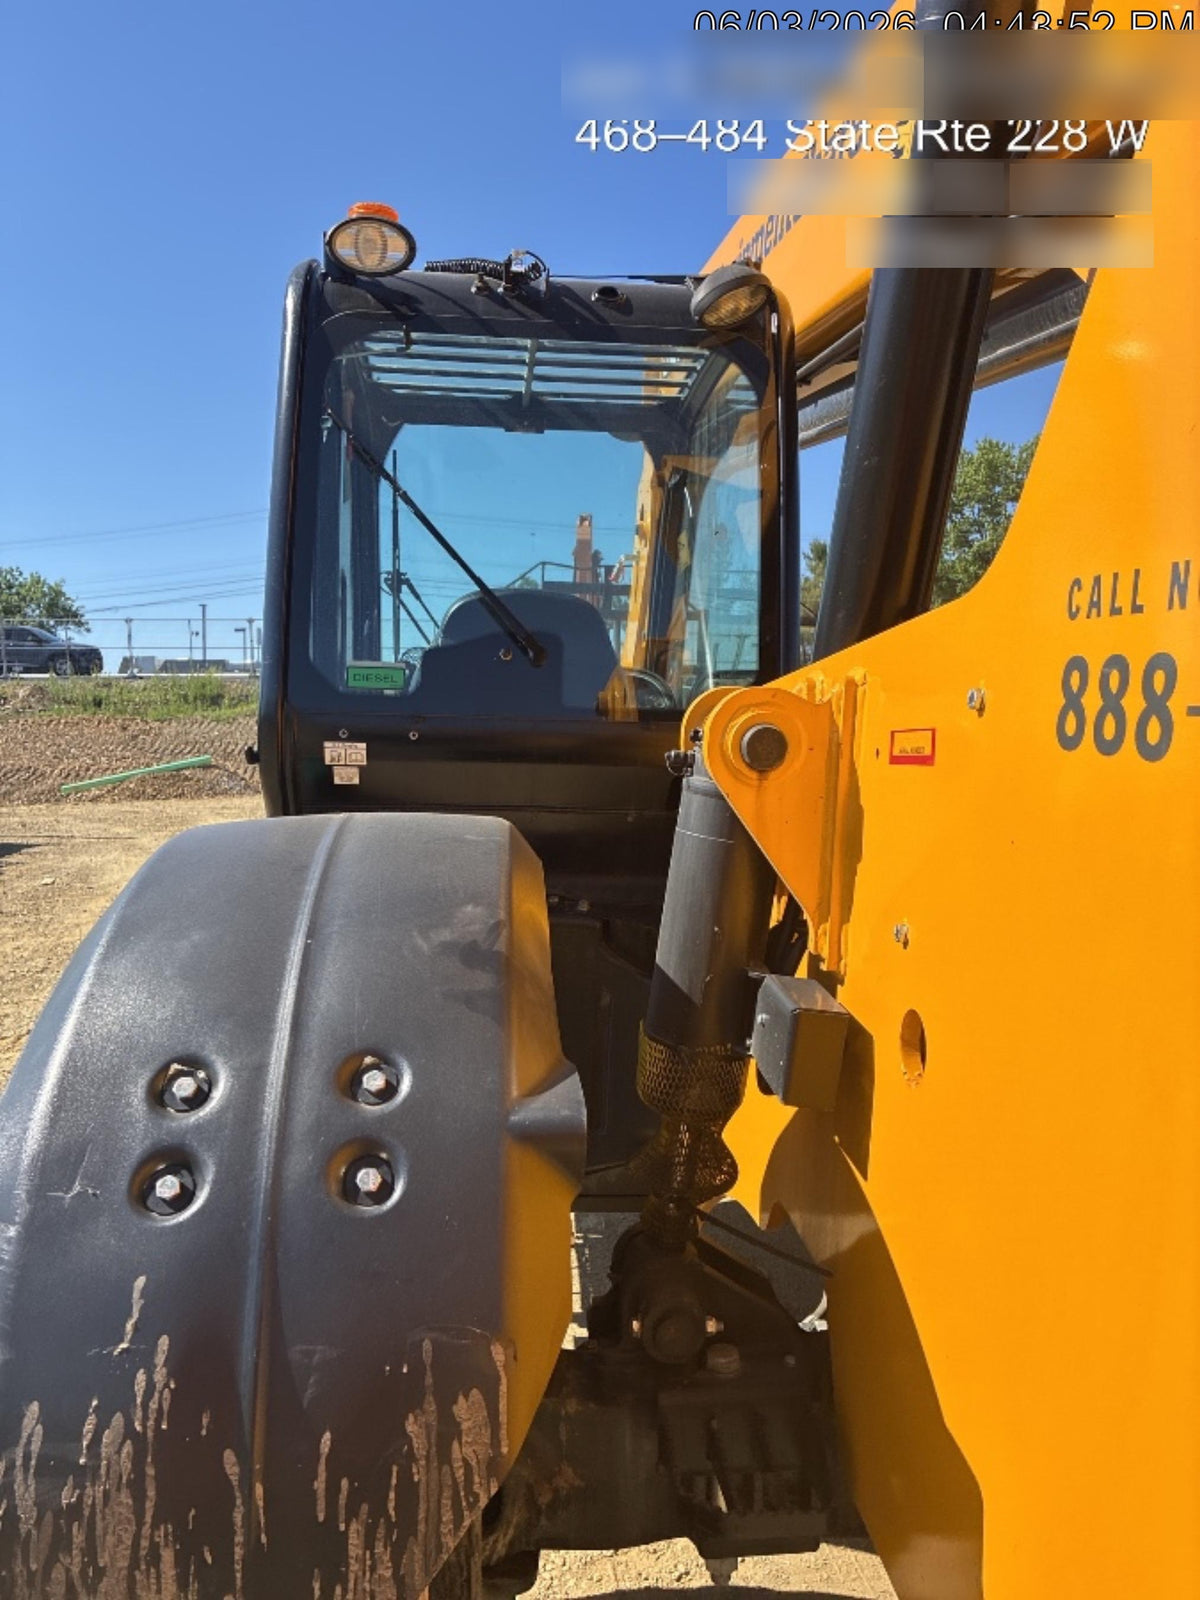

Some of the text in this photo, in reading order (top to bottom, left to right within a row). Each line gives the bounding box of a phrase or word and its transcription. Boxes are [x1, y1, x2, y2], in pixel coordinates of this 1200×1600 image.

[1067, 559, 1200, 621] CALL N
[352, 673, 398, 684] DIESEL
